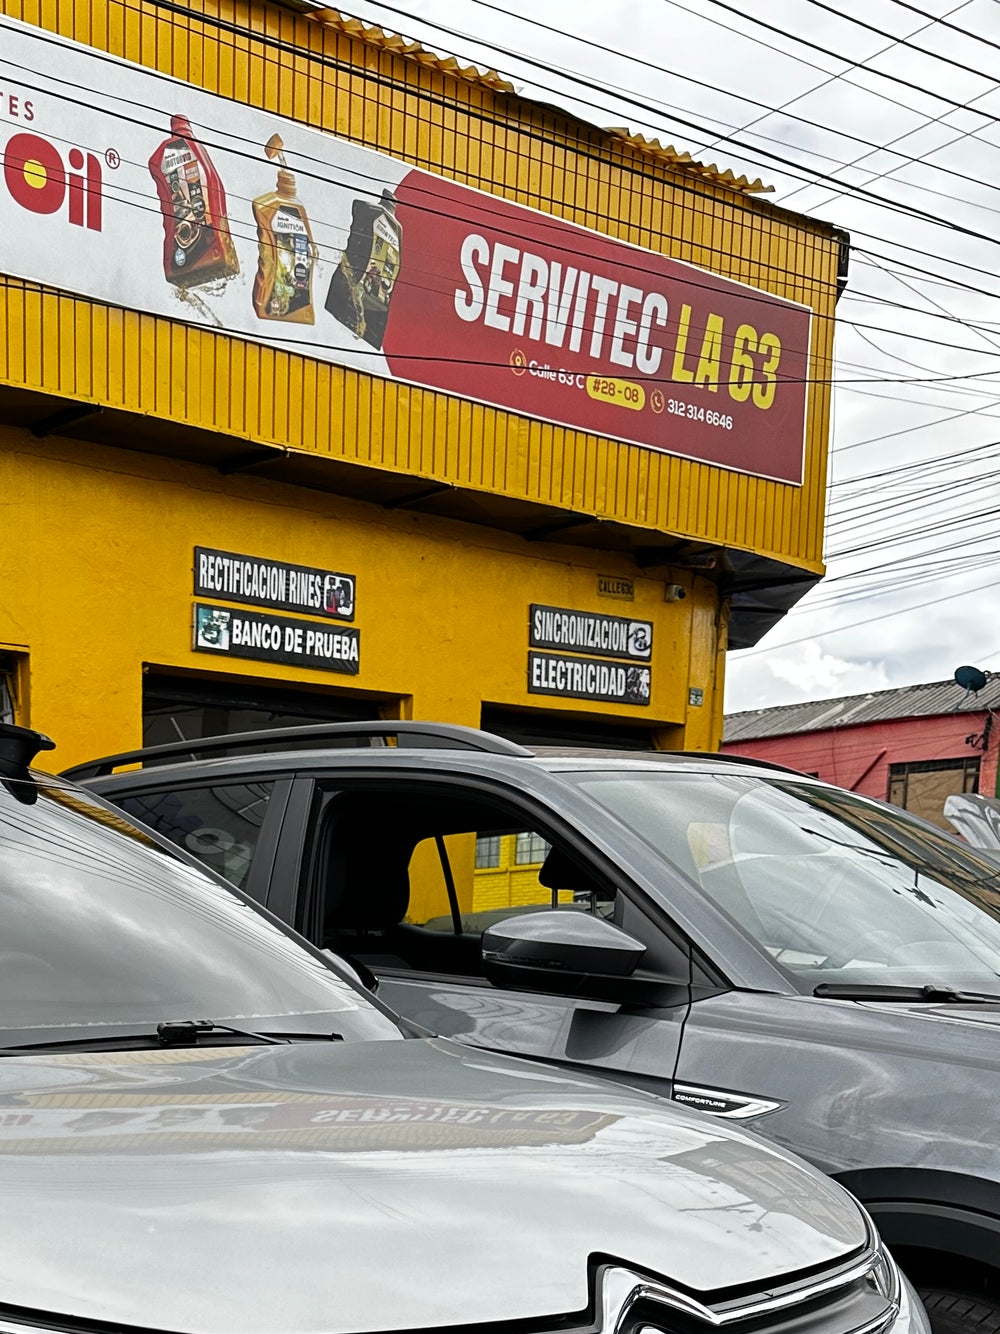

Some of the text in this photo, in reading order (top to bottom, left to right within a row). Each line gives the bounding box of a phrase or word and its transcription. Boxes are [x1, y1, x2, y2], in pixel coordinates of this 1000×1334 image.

[454, 233, 781, 410] SERVITEC LA 63
[529, 360, 557, 383] Calle
[558, 369, 574, 386] 63
[592, 378, 616, 398] #28
[623, 387, 640, 404] 08
[667, 399, 733, 430] 312 314 6646
[199, 553, 322, 608] RECTIFICACION RINES
[232, 618, 359, 662] BANCO DE PRUEBA
[534, 609, 628, 652] SINCRONIZACION
[532, 657, 626, 697] ELECTRICIDAD
[675, 1094, 727, 1108] COMFORTLINE
